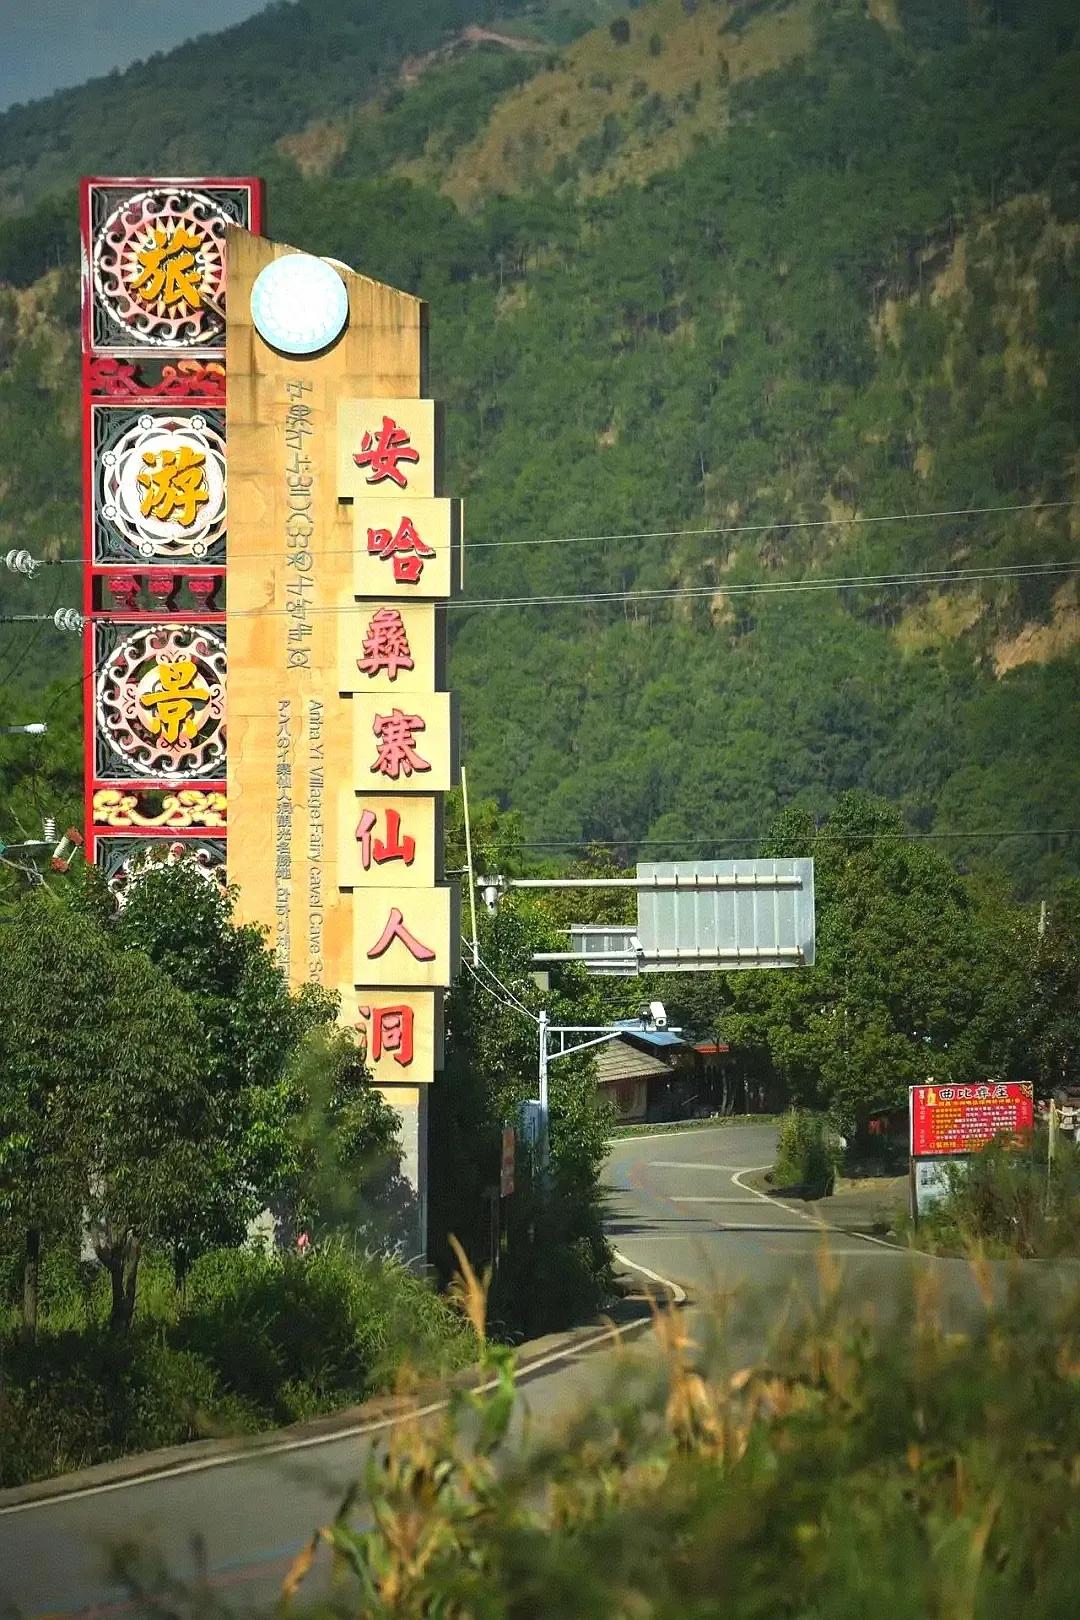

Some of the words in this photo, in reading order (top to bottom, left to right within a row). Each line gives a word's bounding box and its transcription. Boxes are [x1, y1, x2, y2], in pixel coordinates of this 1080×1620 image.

[309, 744, 325, 760] Yi
[353, 413, 437, 1067] 安哈彝寨仙人洞
[308, 766, 325, 819] Village
[307, 823, 325, 862] Fairy
[308, 912, 324, 954] Cave
